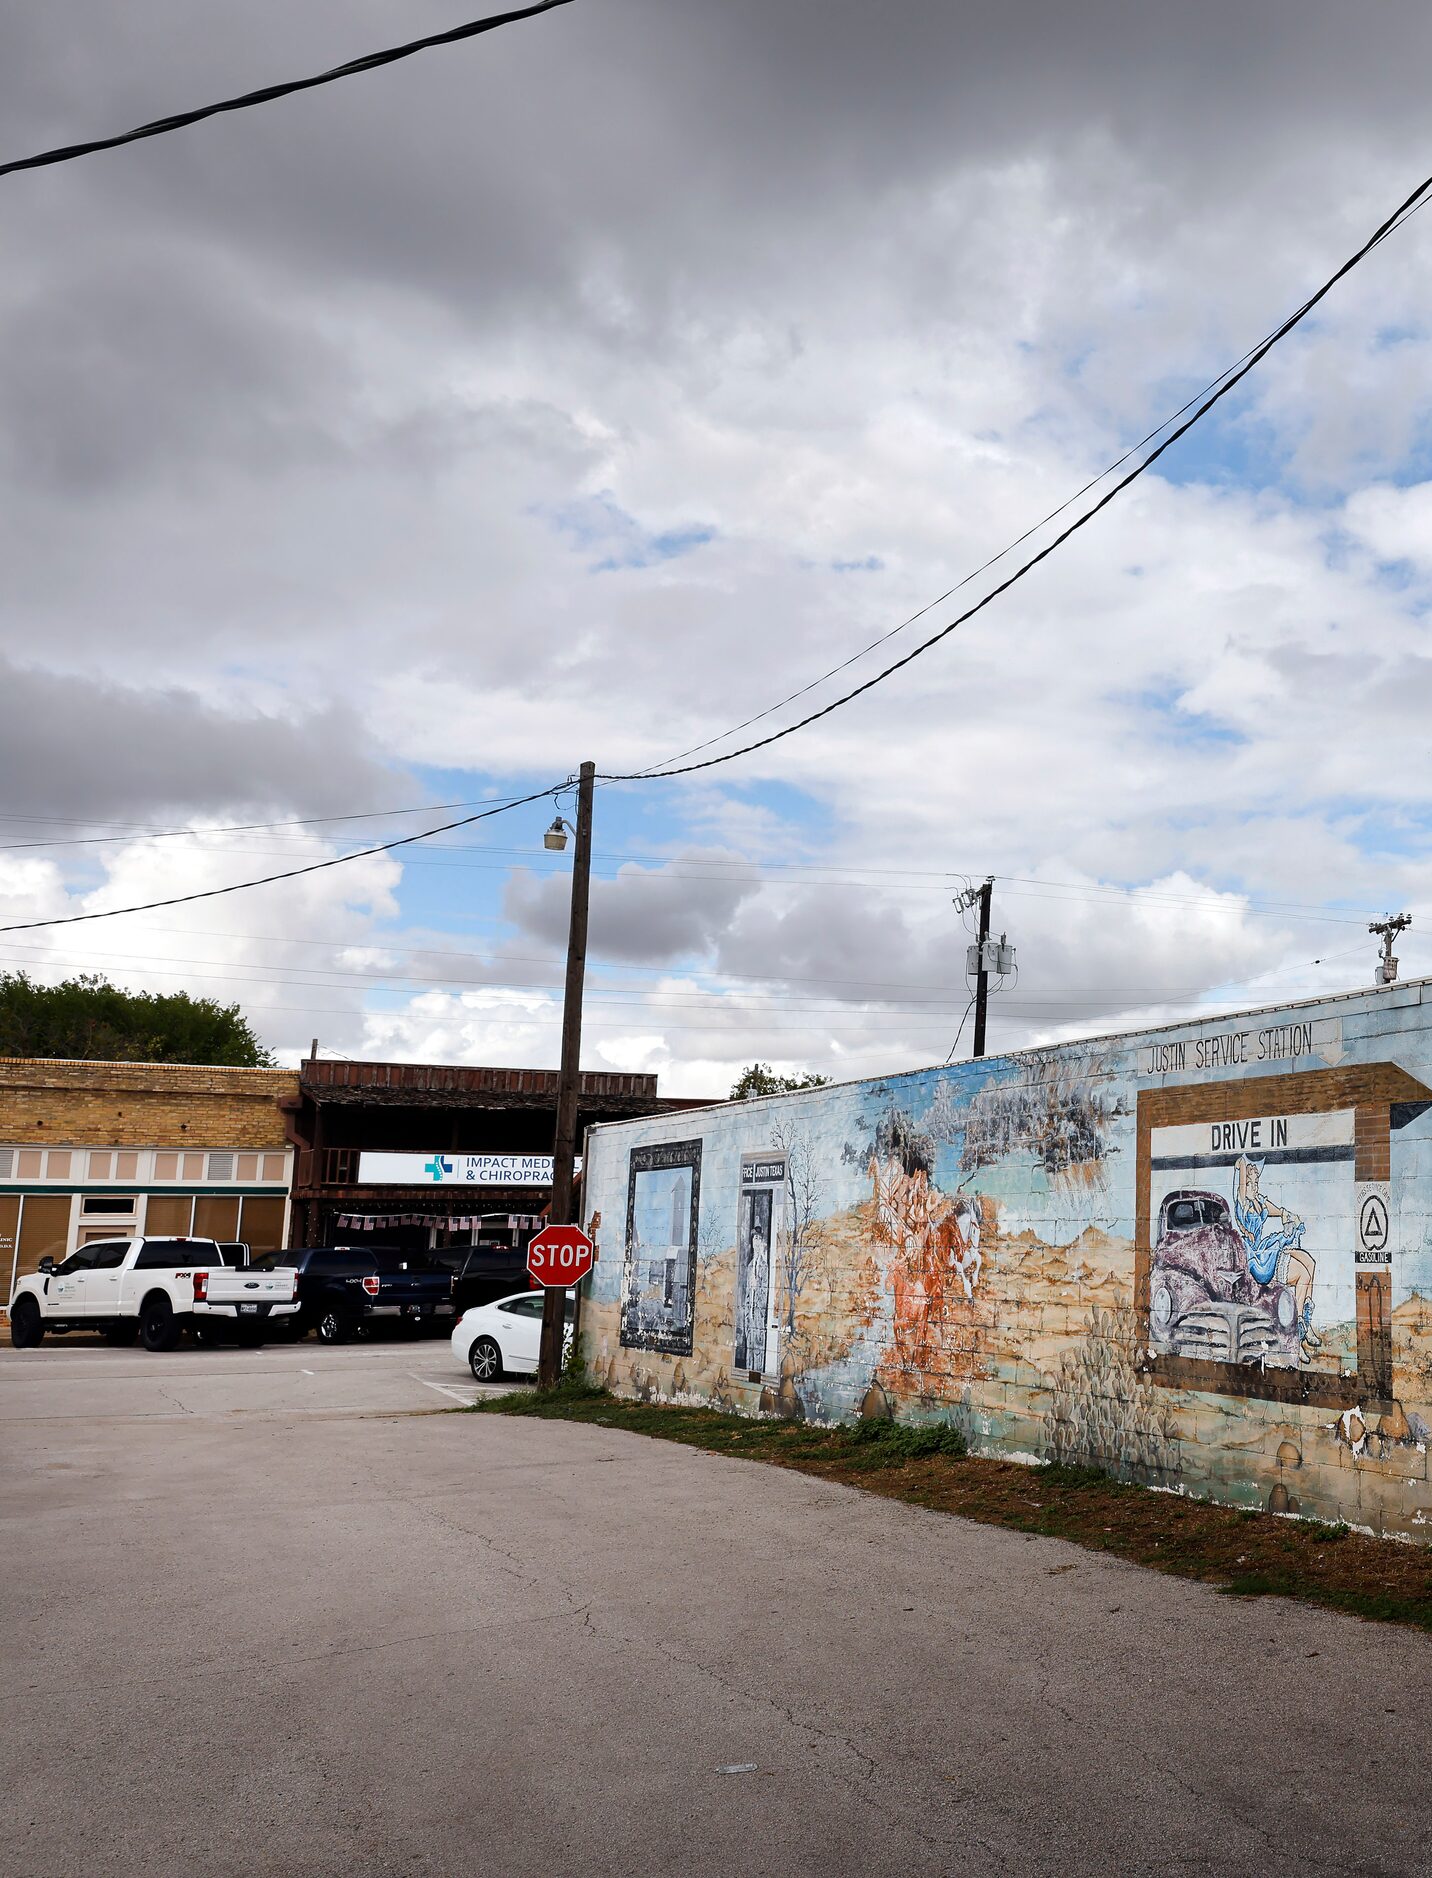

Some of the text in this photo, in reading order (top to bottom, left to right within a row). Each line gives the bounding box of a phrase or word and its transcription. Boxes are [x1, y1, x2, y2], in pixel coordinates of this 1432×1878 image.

[1147, 1023, 1312, 1074] JUSTIN SERVICE STATION
[1211, 1119, 1287, 1151] DRIVE IN
[466, 1157, 517, 1168] IMPACT
[466, 1170, 475, 1180] &
[769, 1165, 783, 1176] TEXAS
[531, 1244, 590, 1267] STOP
[1360, 1252, 1389, 1263] GASOLINE
